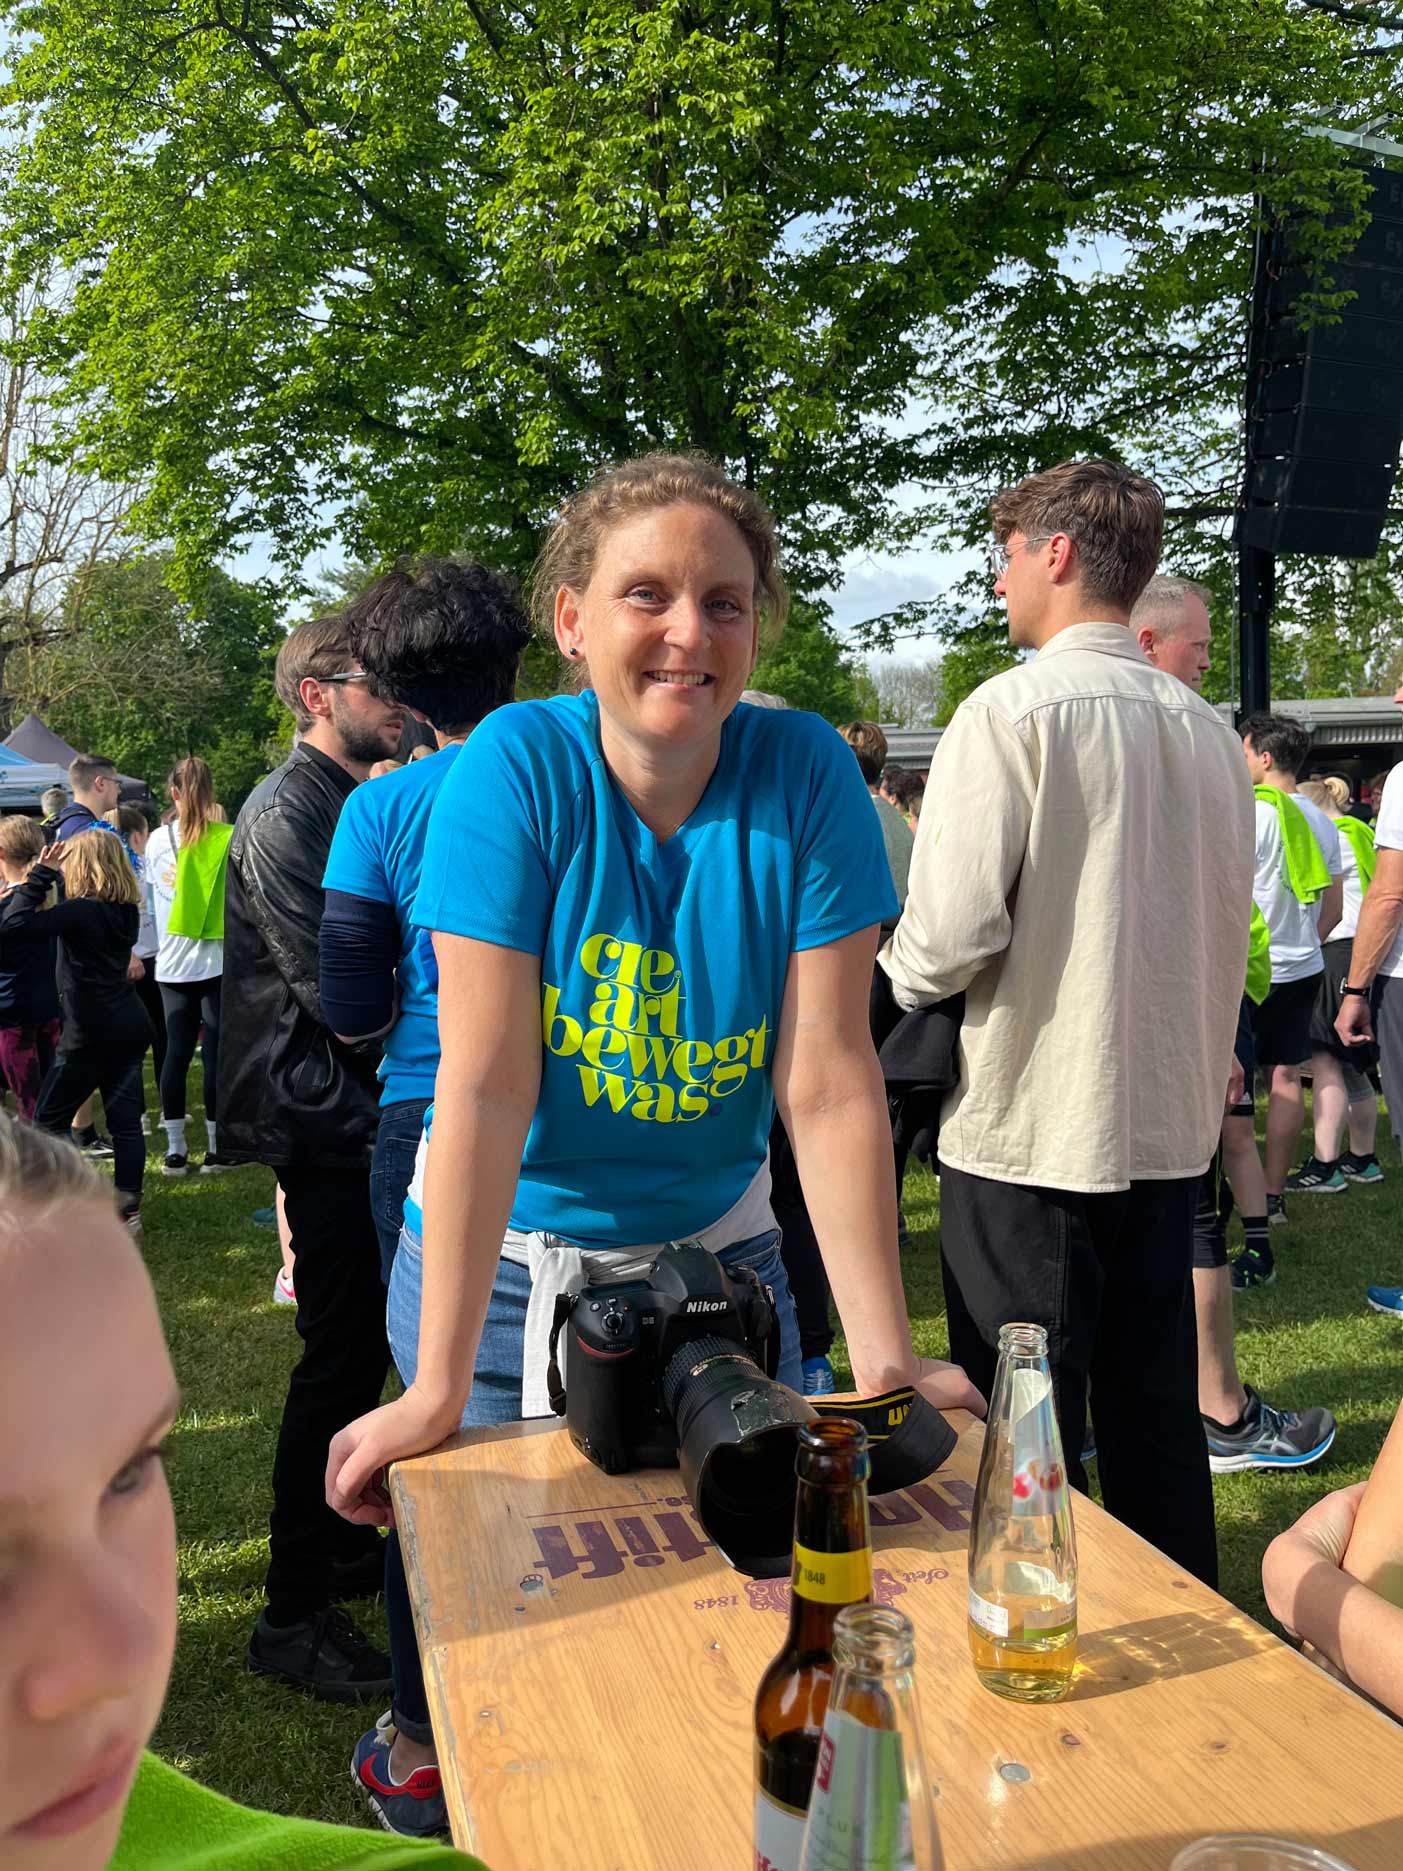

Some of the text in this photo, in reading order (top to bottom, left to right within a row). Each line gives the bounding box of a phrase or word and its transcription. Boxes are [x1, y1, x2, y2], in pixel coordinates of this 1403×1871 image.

[589, 978, 687, 1038] art
[542, 981, 773, 1098] bewegt
[686, 1299, 728, 1314] Nikon
[693, 1568, 949, 1611] Seit 1848
[803, 1570, 826, 1585] 1848
